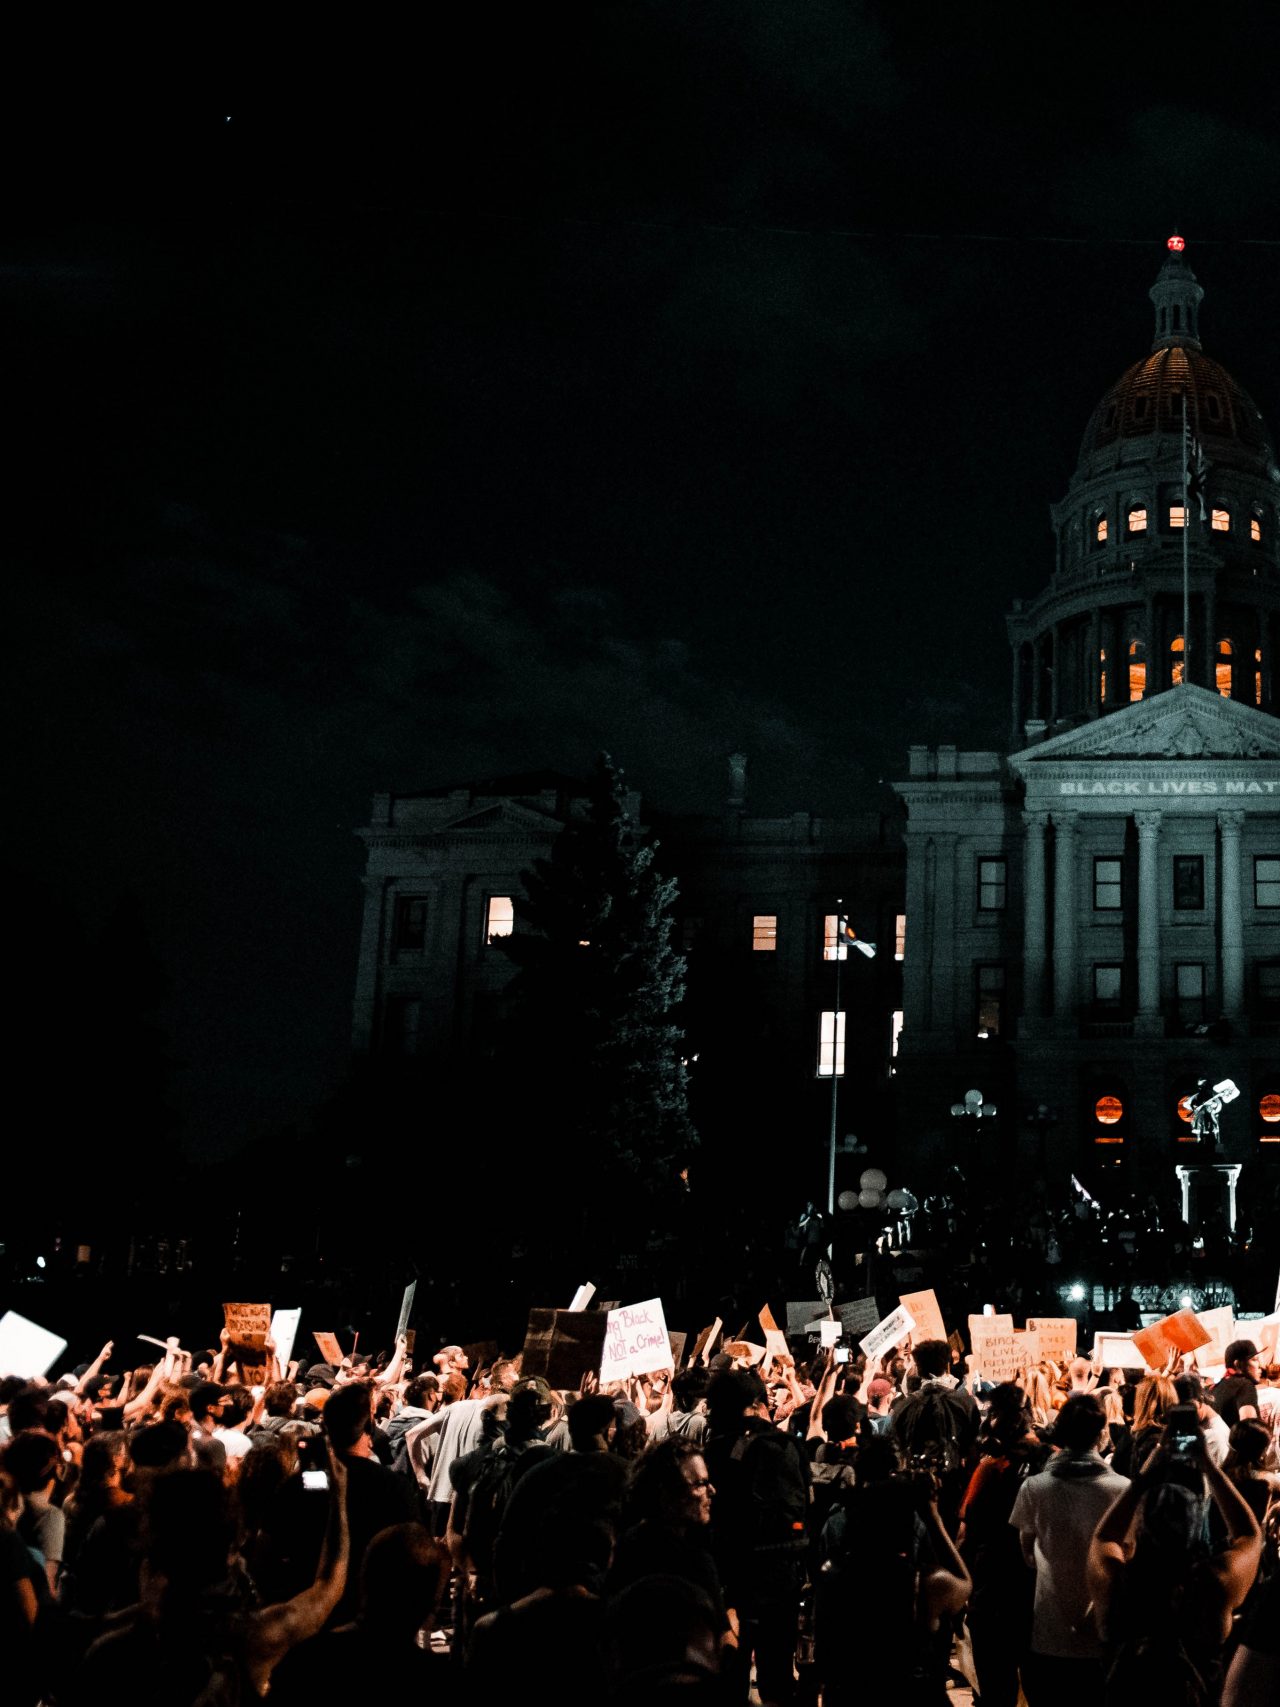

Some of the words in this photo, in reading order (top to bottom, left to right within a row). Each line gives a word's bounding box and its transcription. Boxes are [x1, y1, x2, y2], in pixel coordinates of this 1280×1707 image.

[1060, 782, 1140, 794] BLACK
[1150, 782, 1217, 793] LIVES
[619, 1309, 655, 1328] Black
[609, 1339, 628, 1361] NOT
[629, 1346, 639, 1354] a
